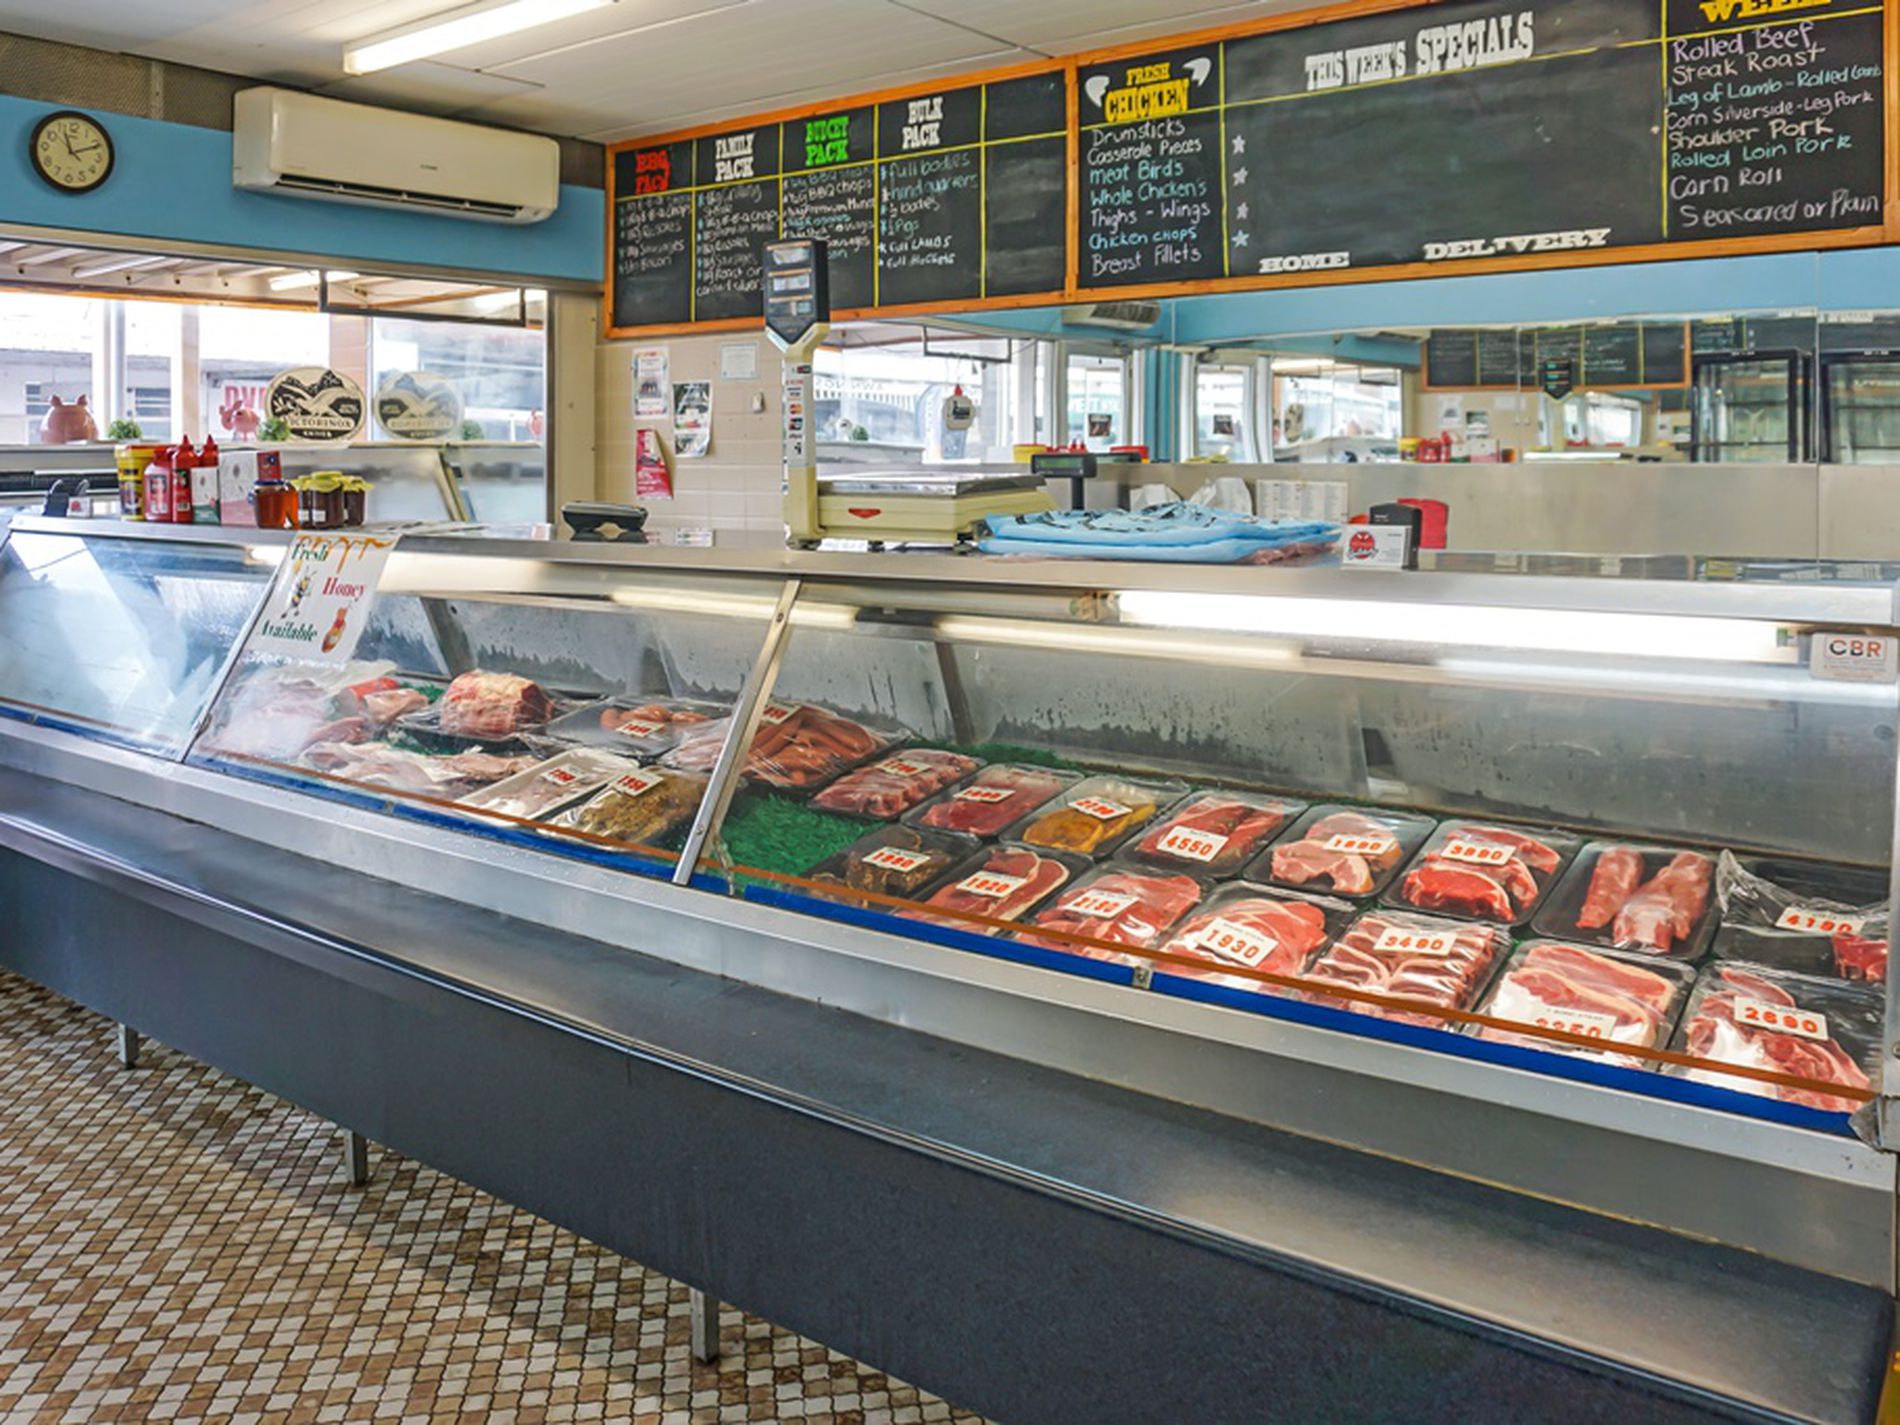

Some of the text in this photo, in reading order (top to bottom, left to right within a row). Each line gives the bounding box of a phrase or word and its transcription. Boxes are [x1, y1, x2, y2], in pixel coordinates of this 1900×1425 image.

[1305, 51, 1344, 91] THIS
[1415, 11, 1534, 75] SPECIALS
[1673, 19, 1815, 63] Rolled Beef
[1126, 62, 1171, 86] FRESH
[1672, 42, 1826, 86] Steak Roast
[1105, 78, 1191, 123] CHICKEN
[1668, 87, 1698, 111] Leg
[1702, 81, 1724, 103] of
[1727, 78, 1782, 99] Lamb
[1796, 68, 1849, 87] Rolled
[908, 97, 943, 124] BULK
[1667, 111, 1708, 131] Corn
[1712, 100, 1795, 125] Silverside
[1834, 90, 1874, 109] Pork
[715, 132, 757, 161] FAMILY
[902, 123, 940, 149] PACK
[1091, 119, 1186, 147] Drumsticks
[1669, 116, 1834, 151] Shoulder Pork
[805, 139, 848, 166] PACK
[1671, 134, 1853, 169] Rolled Loin Pork
[714, 156, 755, 182] PACK
[1670, 168, 1782, 200] Corn Roll
[1090, 208, 1138, 235] Thighs
[1160, 199, 1211, 225] Wings
[1803, 201, 1828, 219] or
[1088, 232, 1149, 251] Chicken
[1258, 228, 1612, 274] HOME DELIVERY
[1091, 251, 1142, 277] Breast
[1829, 638, 1882, 658] CBR
[1166, 834, 1213, 857] 4550
[1206, 928, 1260, 962] 1930
